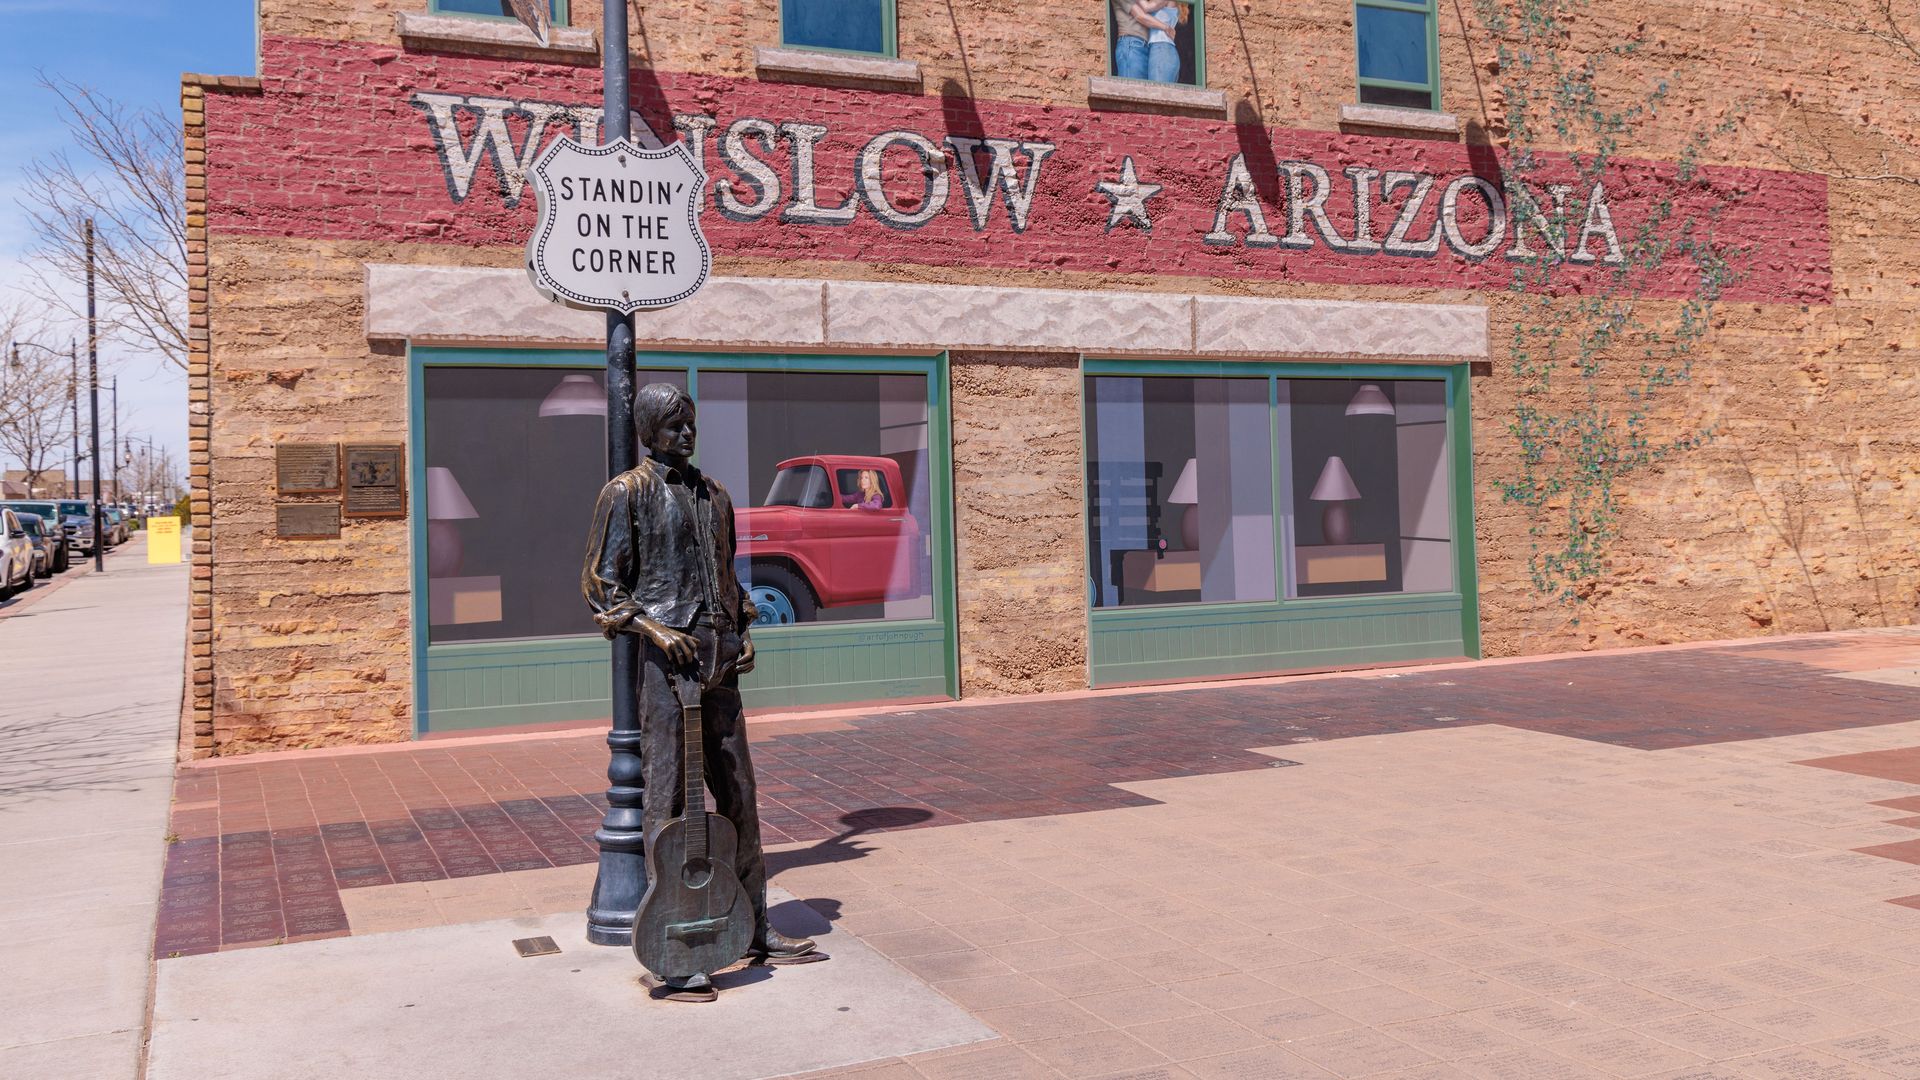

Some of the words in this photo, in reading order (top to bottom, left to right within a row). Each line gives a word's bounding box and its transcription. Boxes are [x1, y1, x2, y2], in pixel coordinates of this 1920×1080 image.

[560, 176, 684, 205] STANDIN'
[1203, 151, 1625, 266] ARIZONA
[577, 213, 611, 238] ON
[622, 214, 670, 240] THE
[572, 247, 676, 275] CORNER
